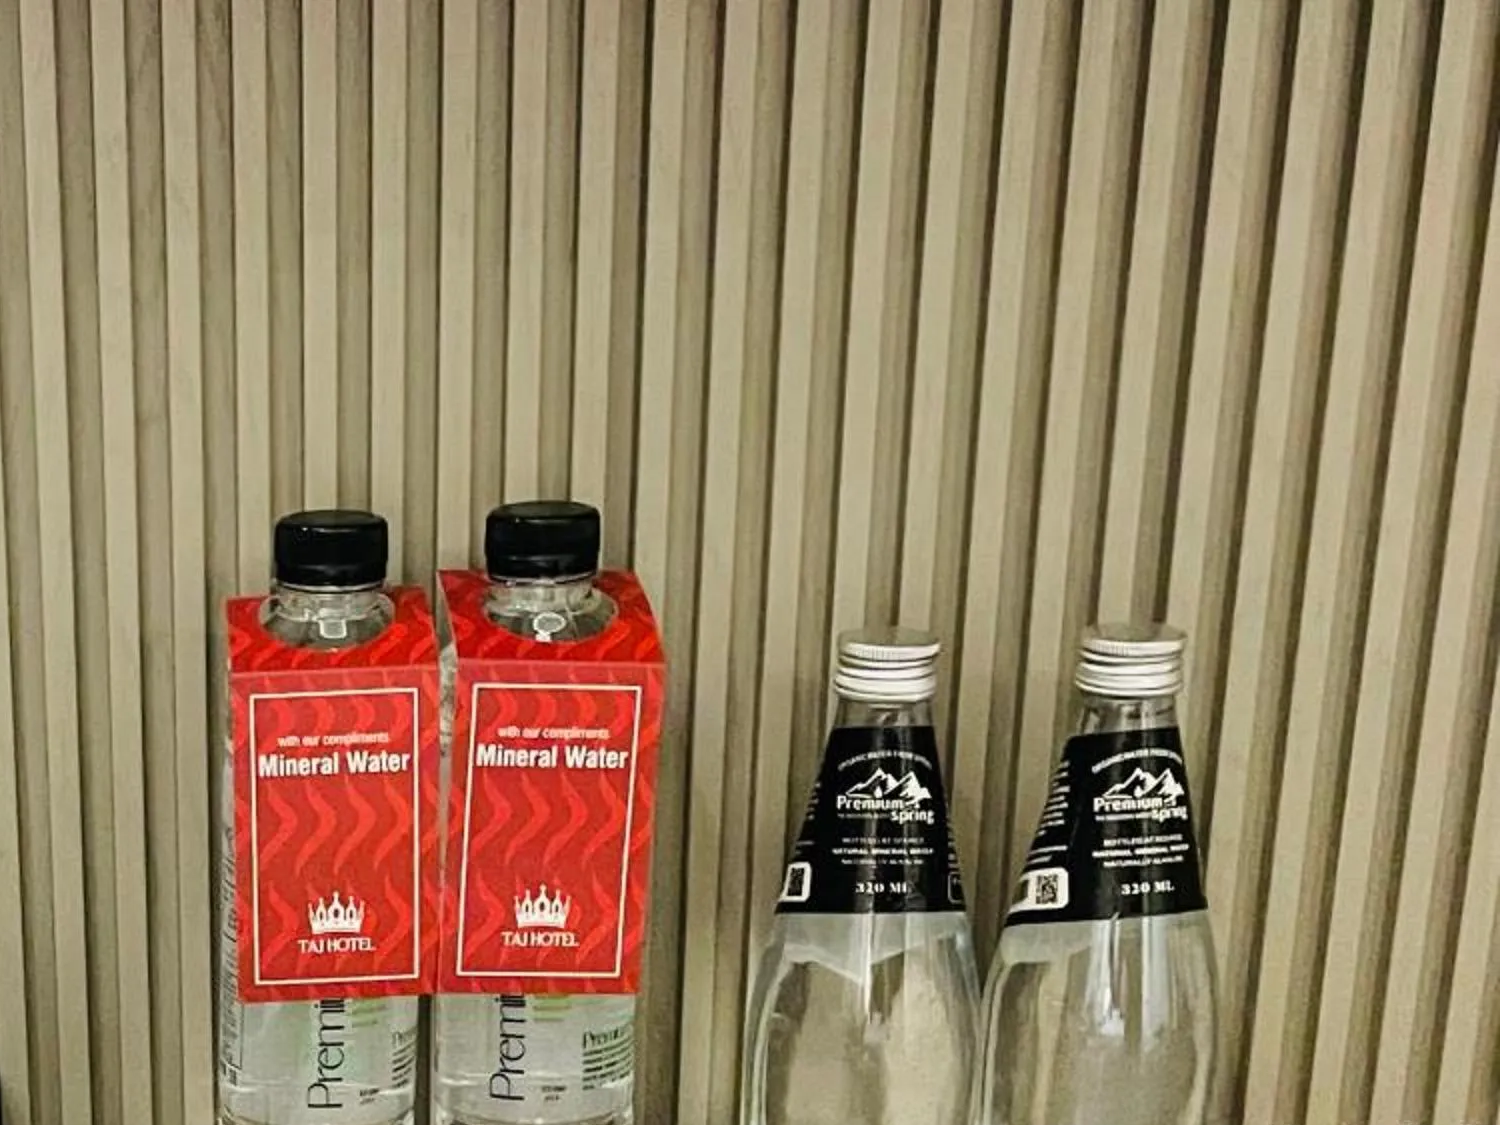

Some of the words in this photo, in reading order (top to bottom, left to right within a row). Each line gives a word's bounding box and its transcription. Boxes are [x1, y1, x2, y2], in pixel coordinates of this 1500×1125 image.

[258, 751, 339, 777] Mineral
[346, 750, 410, 774] Water
[475, 743, 558, 767] Mineral
[564, 745, 628, 769] Water
[836, 795, 905, 811] Premium
[1093, 797, 1163, 812] Premium
[890, 804, 934, 825] spring
[297, 939, 324, 955] TAJ
[327, 937, 376, 953] HOTEL
[501, 931, 528, 947] TAJ
[530, 931, 580, 947] HOTEL
